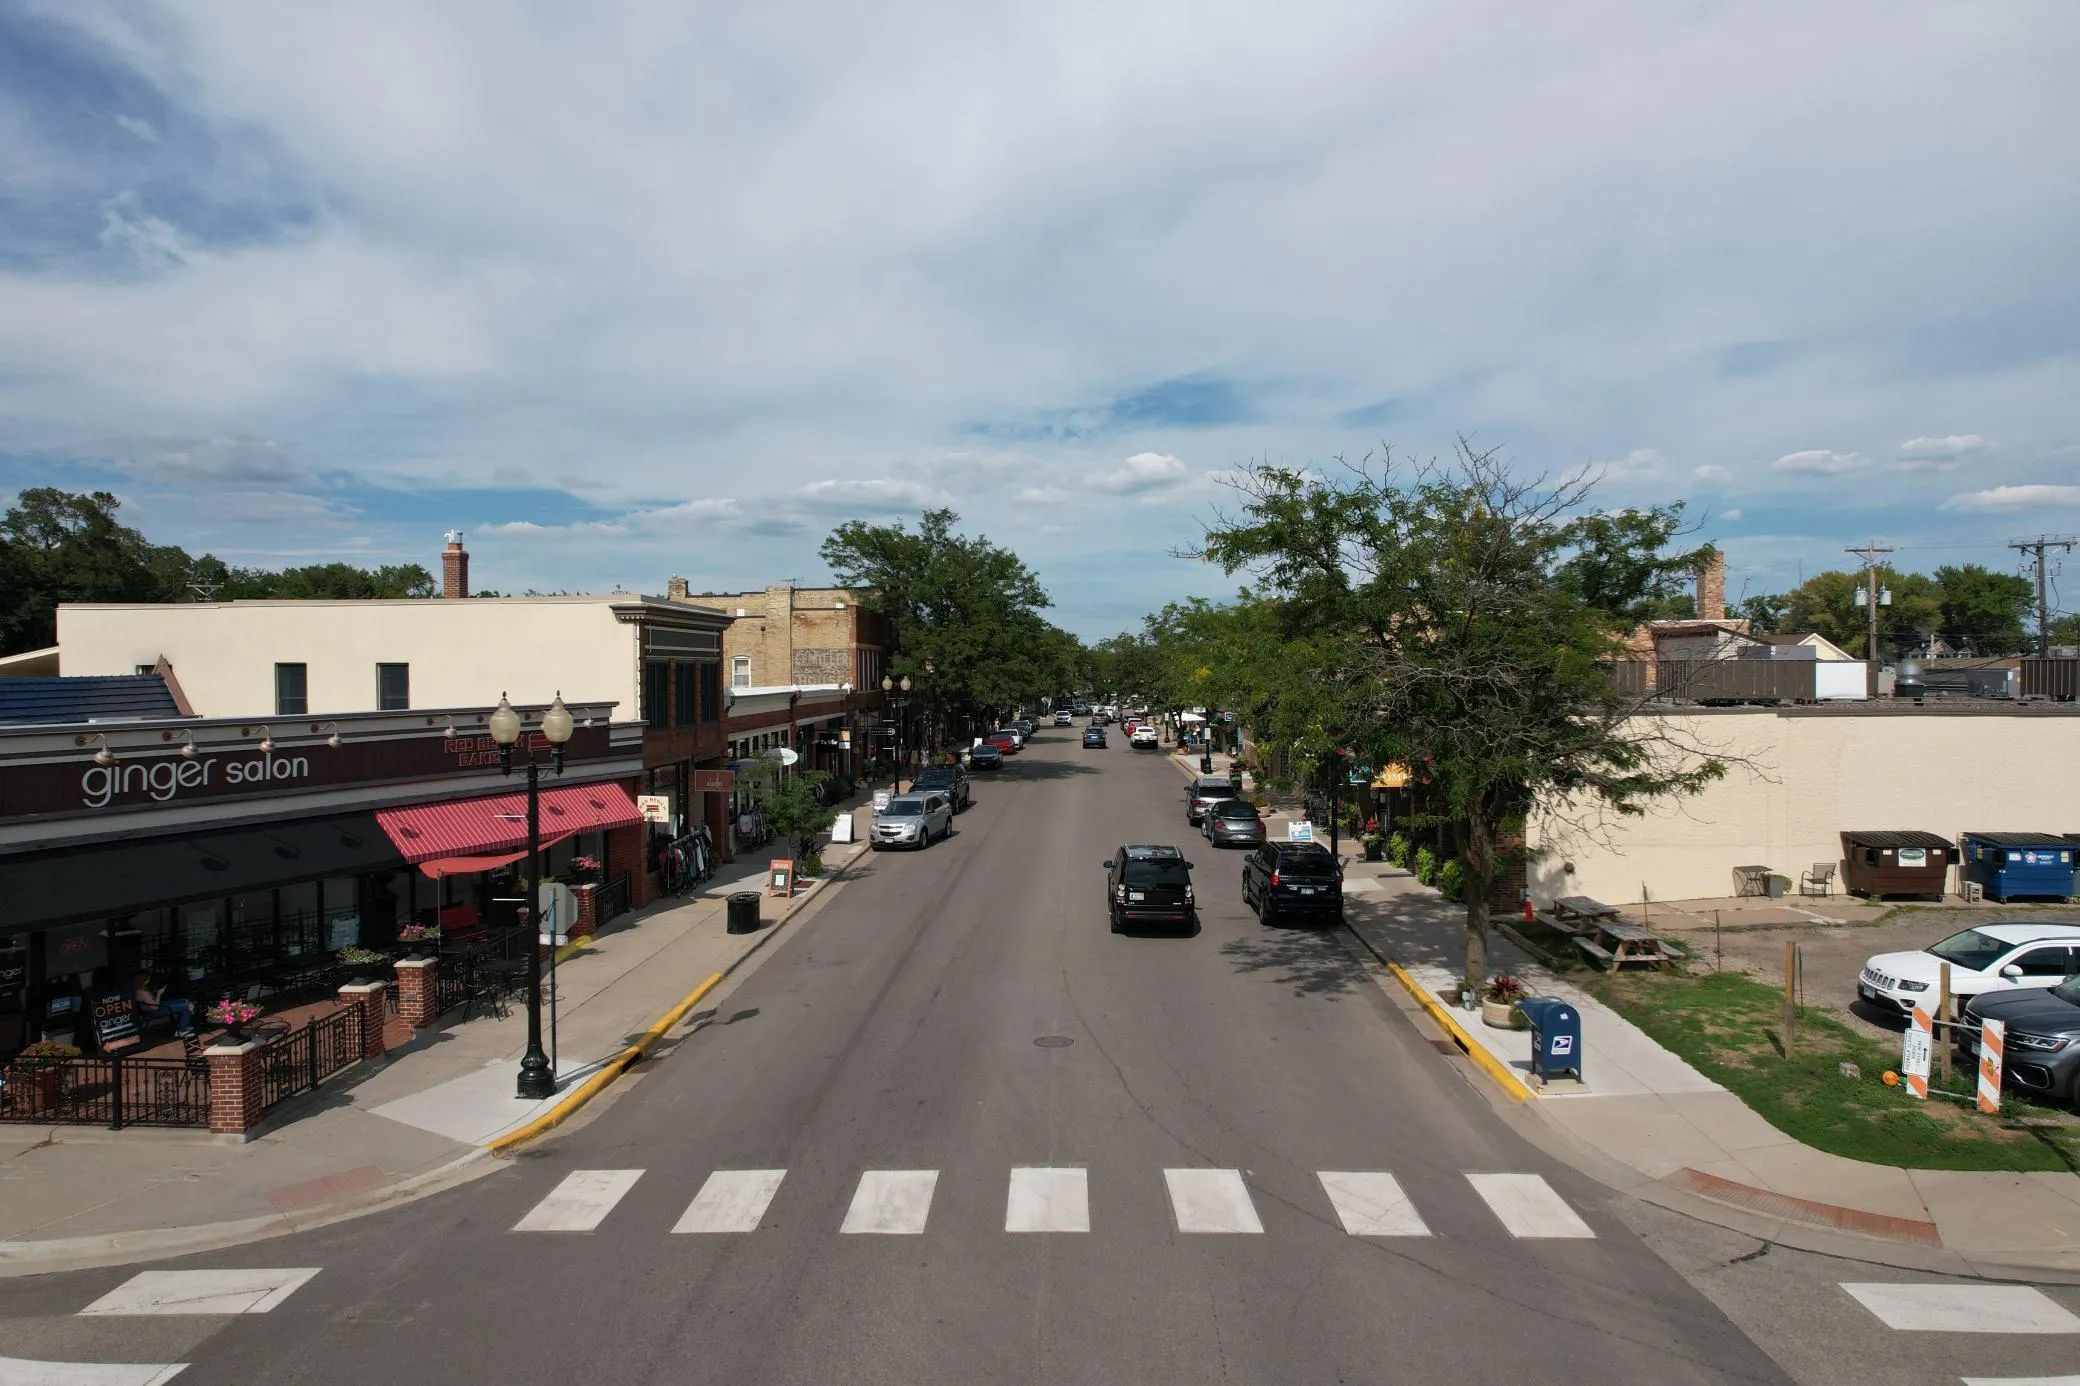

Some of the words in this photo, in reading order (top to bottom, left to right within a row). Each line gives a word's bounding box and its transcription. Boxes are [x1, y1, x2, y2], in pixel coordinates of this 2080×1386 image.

[444, 737, 474, 753] RED
[81, 758, 217, 808] ginger
[225, 752, 309, 784] salon
[95, 999, 133, 1018] OPEN
[102, 994, 121, 1004] NOW
[99, 1012, 133, 1031] ginger
